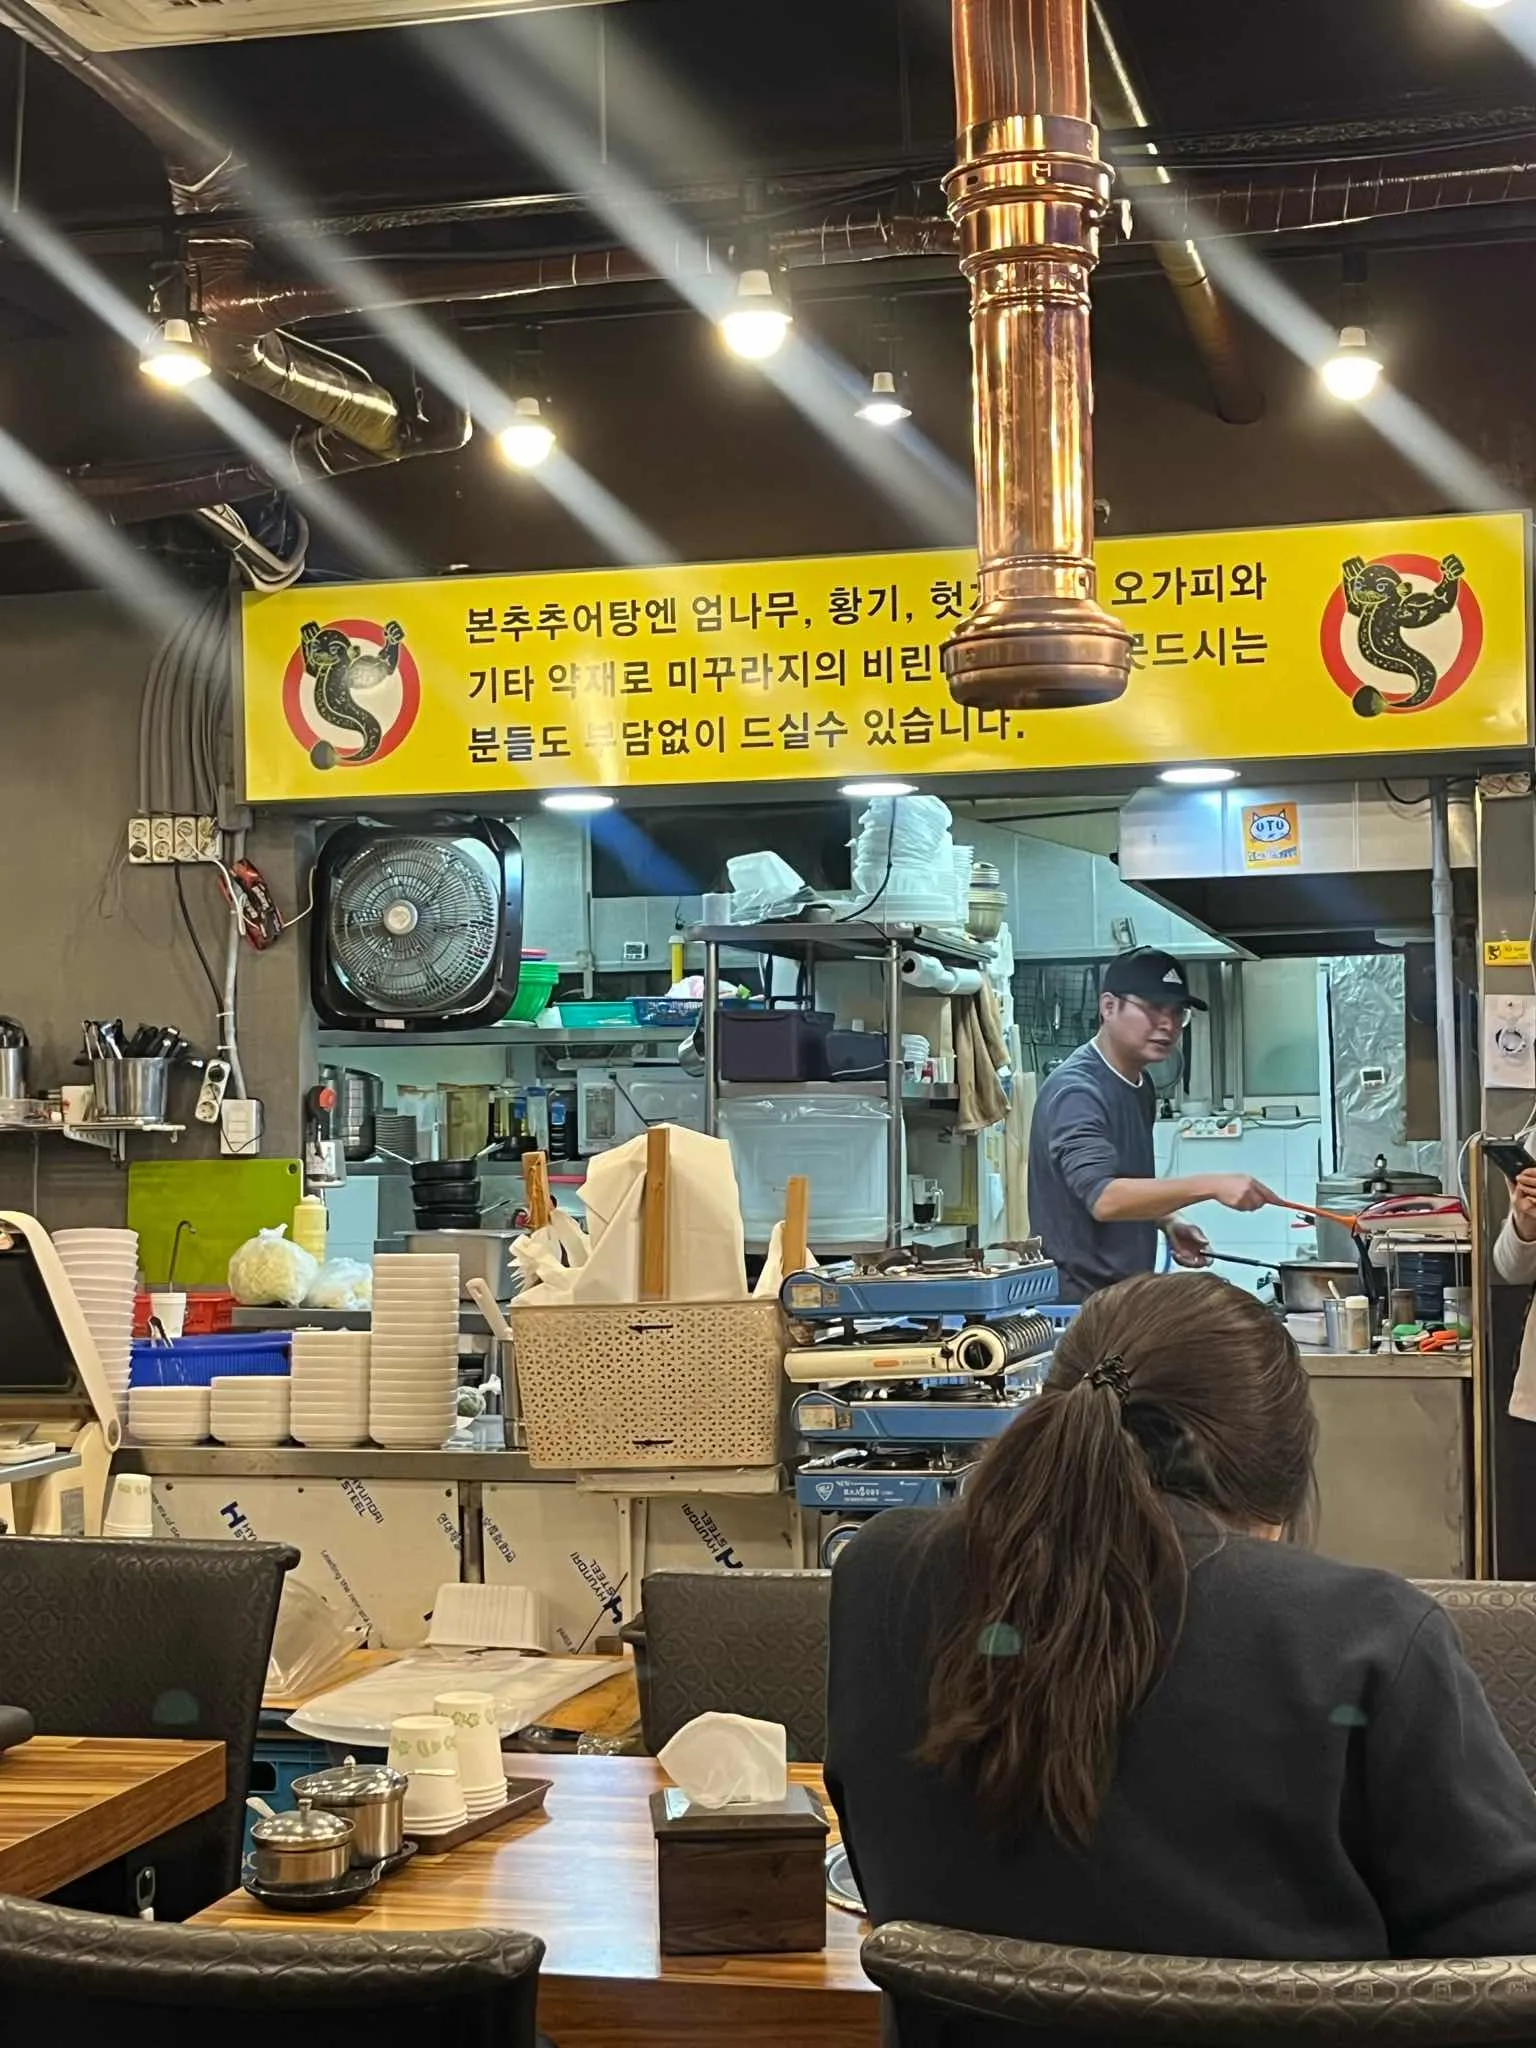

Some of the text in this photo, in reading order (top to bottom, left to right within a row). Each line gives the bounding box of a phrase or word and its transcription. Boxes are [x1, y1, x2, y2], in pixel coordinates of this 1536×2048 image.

[465, 597, 677, 644] 본추추어탕엔
[692, 592, 812, 632] 엄나무,
[828, 584, 913, 625] 황기,
[1111, 561, 1268, 606] 오가피와
[468, 663, 534, 703] 기타
[548, 660, 653, 699] 약재로
[668, 649, 846, 694] 미꾸라지의
[863, 641, 946, 684] 비린
[468, 725, 571, 763] 분들도
[740, 710, 848, 750] 드실수
[864, 704, 1026, 746] 있습니다.
[680, 1503, 720, 1554] HYUNDAI
[701, 1511, 728, 1548] STEEL
[569, 1551, 608, 1602] HYUNDAI
[590, 1559, 617, 1597] STEEL
